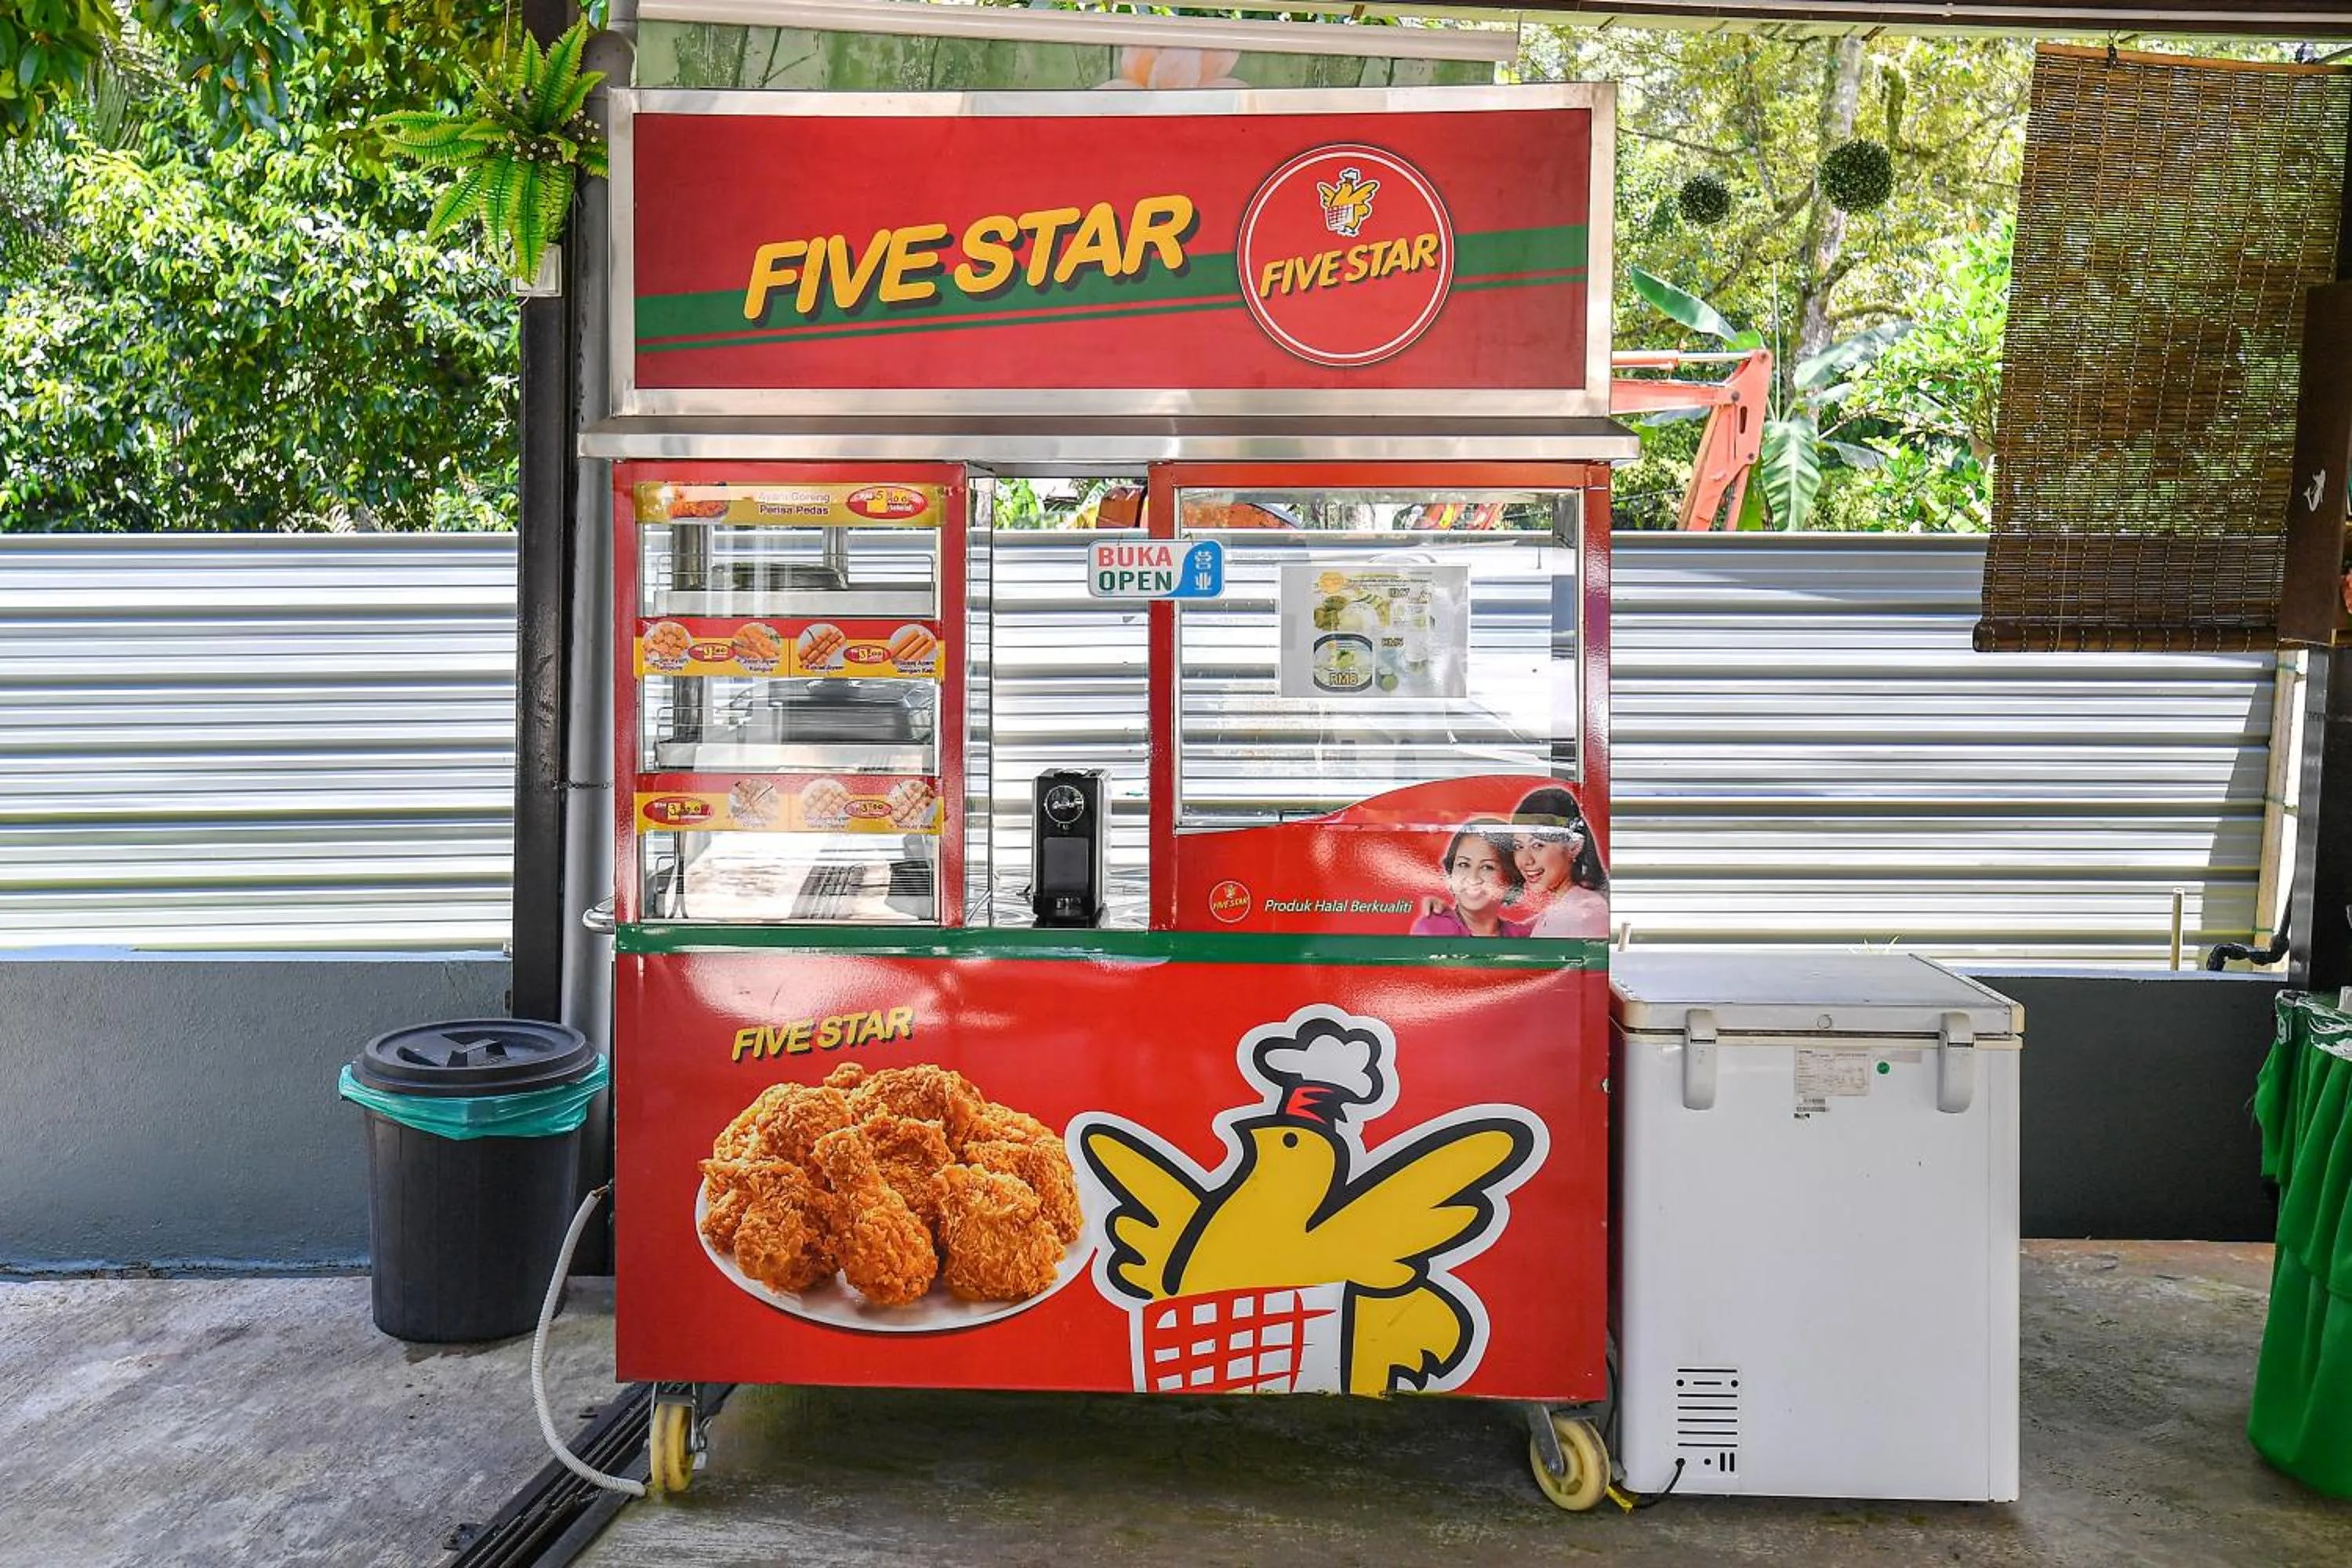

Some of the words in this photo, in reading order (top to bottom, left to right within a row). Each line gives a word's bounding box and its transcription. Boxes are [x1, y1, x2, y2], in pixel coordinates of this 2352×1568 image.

[744, 223, 949, 323] FIVE
[954, 194, 1197, 296] STAR
[1259, 250, 1343, 298] FIVE
[1344, 233, 1439, 282] STAR
[792, 492, 830, 503] Goreng
[759, 504, 793, 514] Perisa
[796, 504, 829, 514] Pedas
[1098, 546, 1173, 567] BUKA
[1098, 570, 1173, 590] OPEN
[1265, 899, 1310, 912] Produk
[1315, 900, 1346, 913] Halal
[1349, 901, 1414, 913] Berkualiti
[731, 1018, 816, 1062] FIVE
[817, 1006, 915, 1049] STAR
